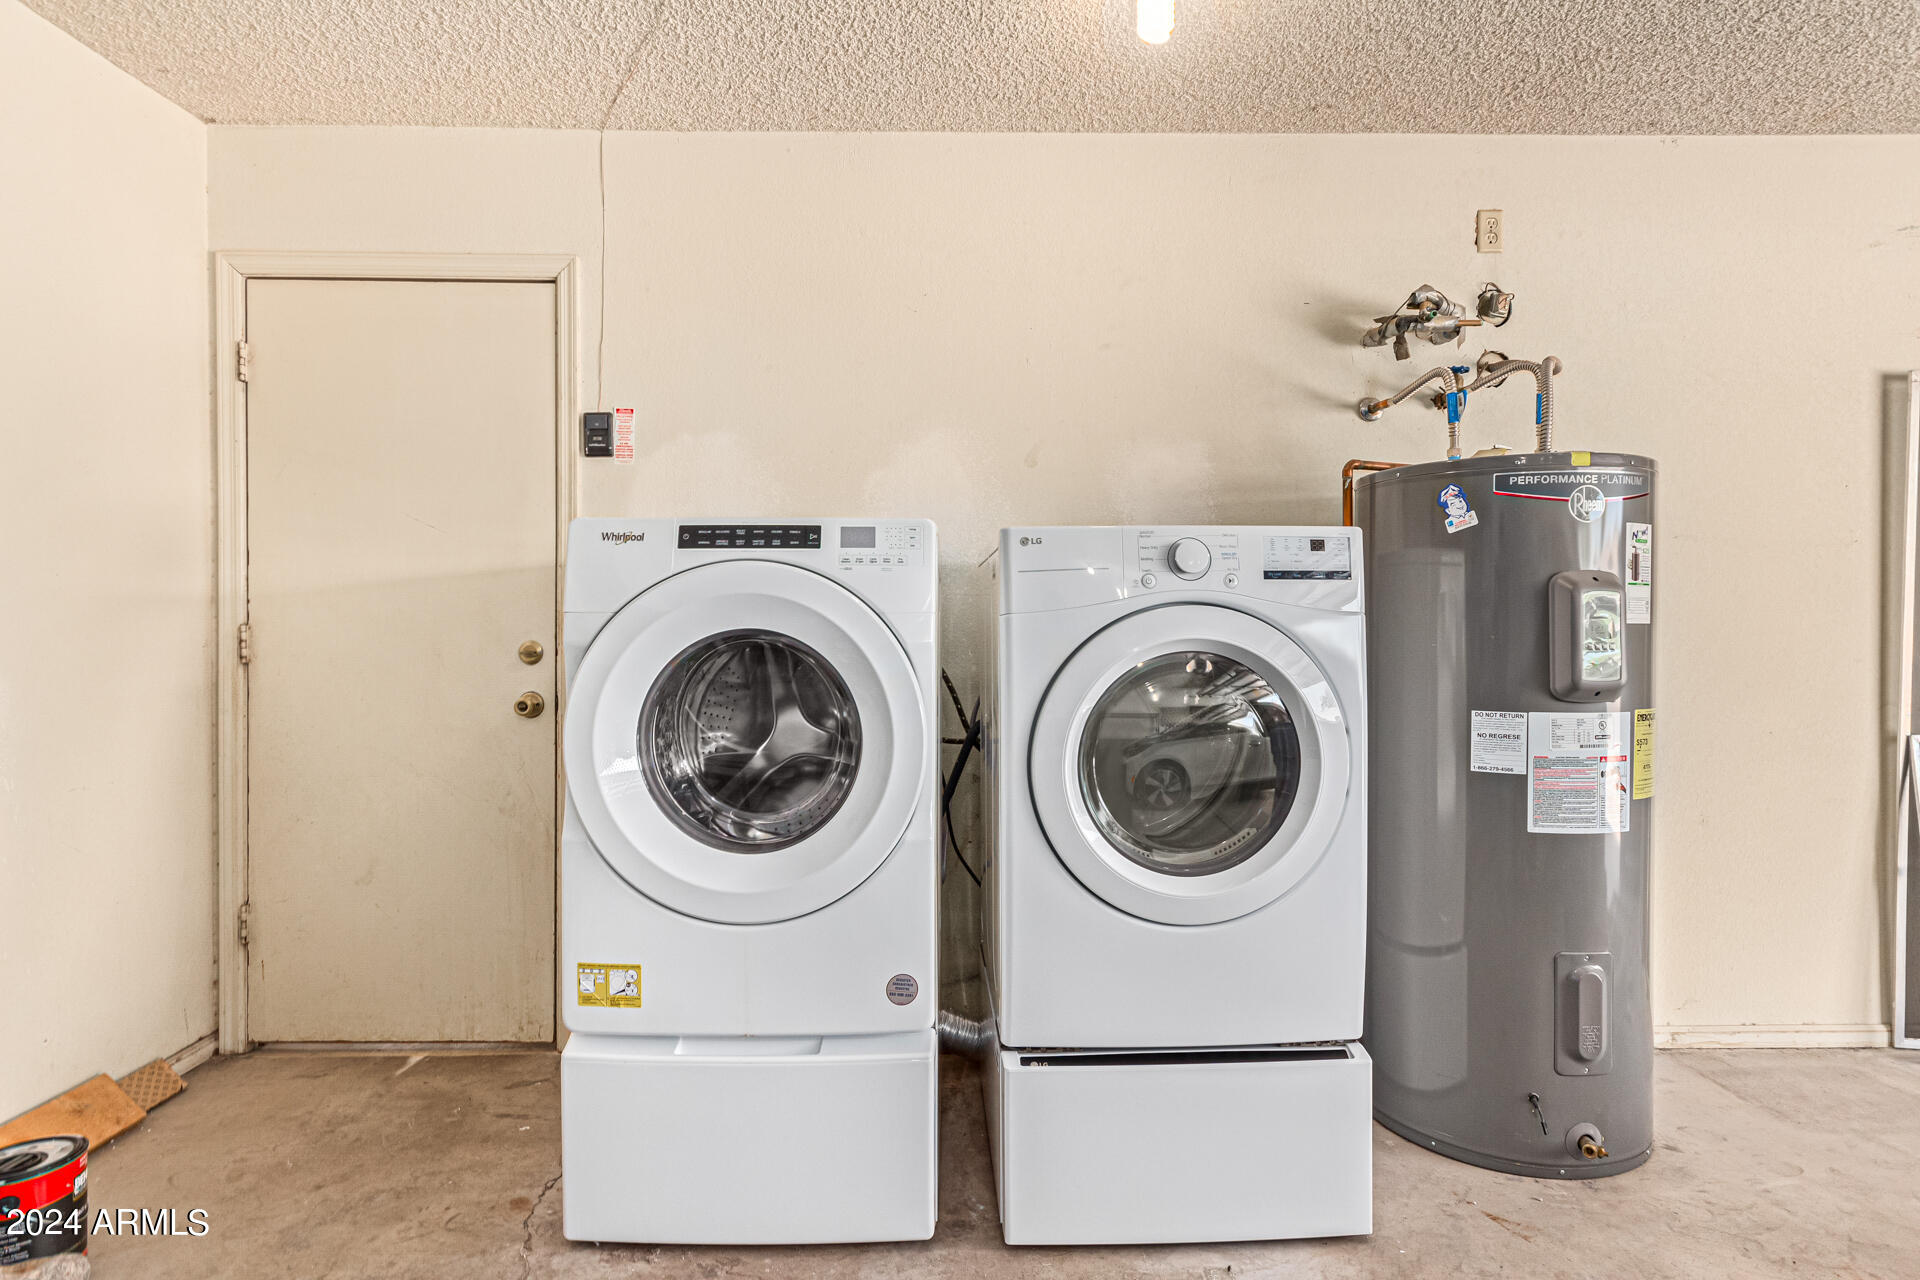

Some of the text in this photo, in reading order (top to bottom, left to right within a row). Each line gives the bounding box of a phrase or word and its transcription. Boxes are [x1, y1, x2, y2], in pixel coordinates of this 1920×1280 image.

[1509, 475, 1643, 486] PERFORMANCE PLATINUM
[1574, 487, 1603, 518] Rheem
[601, 531, 645, 544] Whirlpool
[1030, 537, 1043, 545] LG
